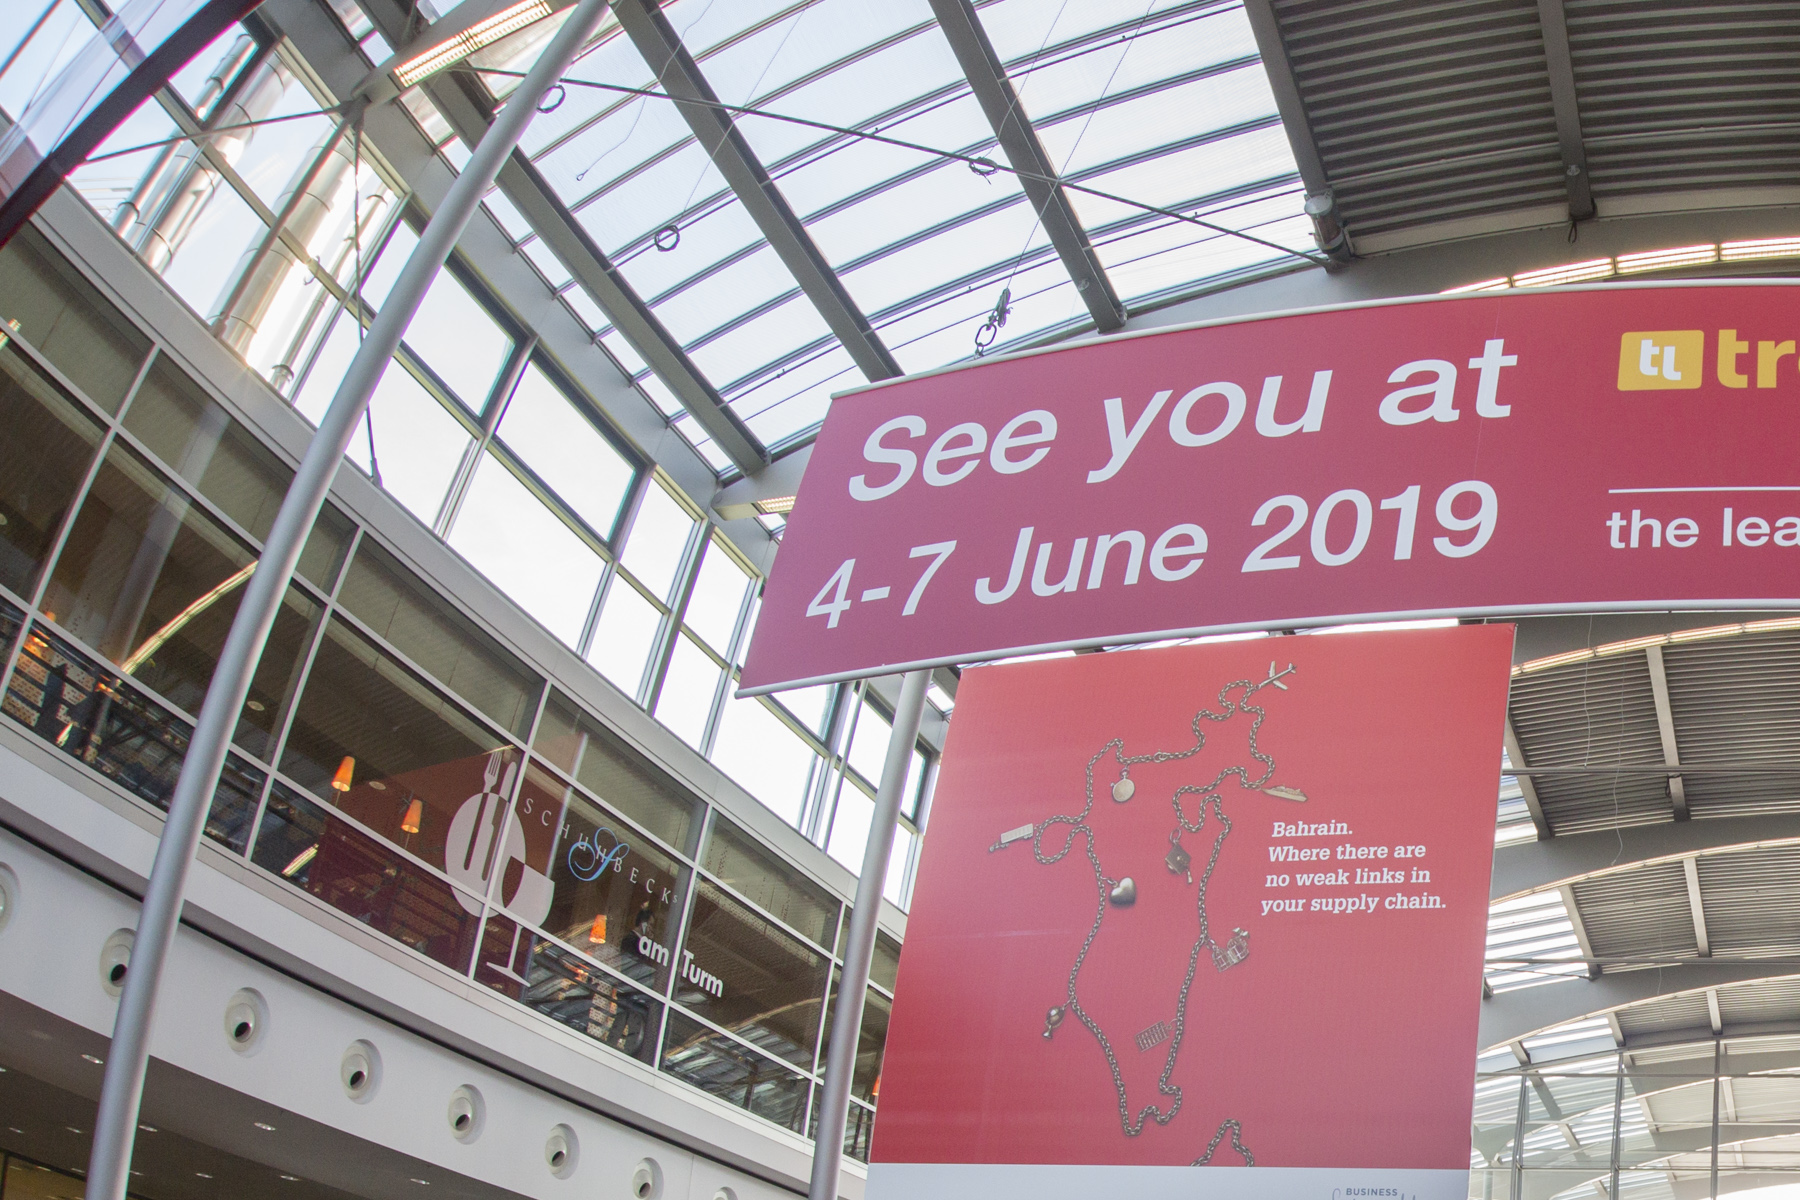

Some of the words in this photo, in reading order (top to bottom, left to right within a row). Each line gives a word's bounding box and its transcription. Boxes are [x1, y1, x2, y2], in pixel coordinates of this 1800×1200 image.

[848, 409, 1058, 502] See
[1086, 369, 1333, 484] you
[1378, 338, 1518, 426] at
[1605, 508, 1700, 549] the
[805, 539, 956, 629] 4-7
[975, 525, 1208, 606] June
[1241, 480, 1499, 574] 2019
[1271, 819, 1353, 838] Bahrain.
[1268, 844, 1331, 863] Where
[1335, 842, 1387, 861] there
[1392, 844, 1426, 860] are
[1265, 873, 1290, 888] no
[1294, 867, 1350, 886] weak
[1354, 866, 1405, 885] links
[1410, 866, 1431, 884] in
[1260, 896, 1306, 915] your
[1310, 892, 1380, 914] supply
[1384, 892, 1447, 910] chain.
[638, 935, 670, 967] am
[681, 948, 724, 998] Turm
[1345, 1187, 1399, 1198] BUSINESS
